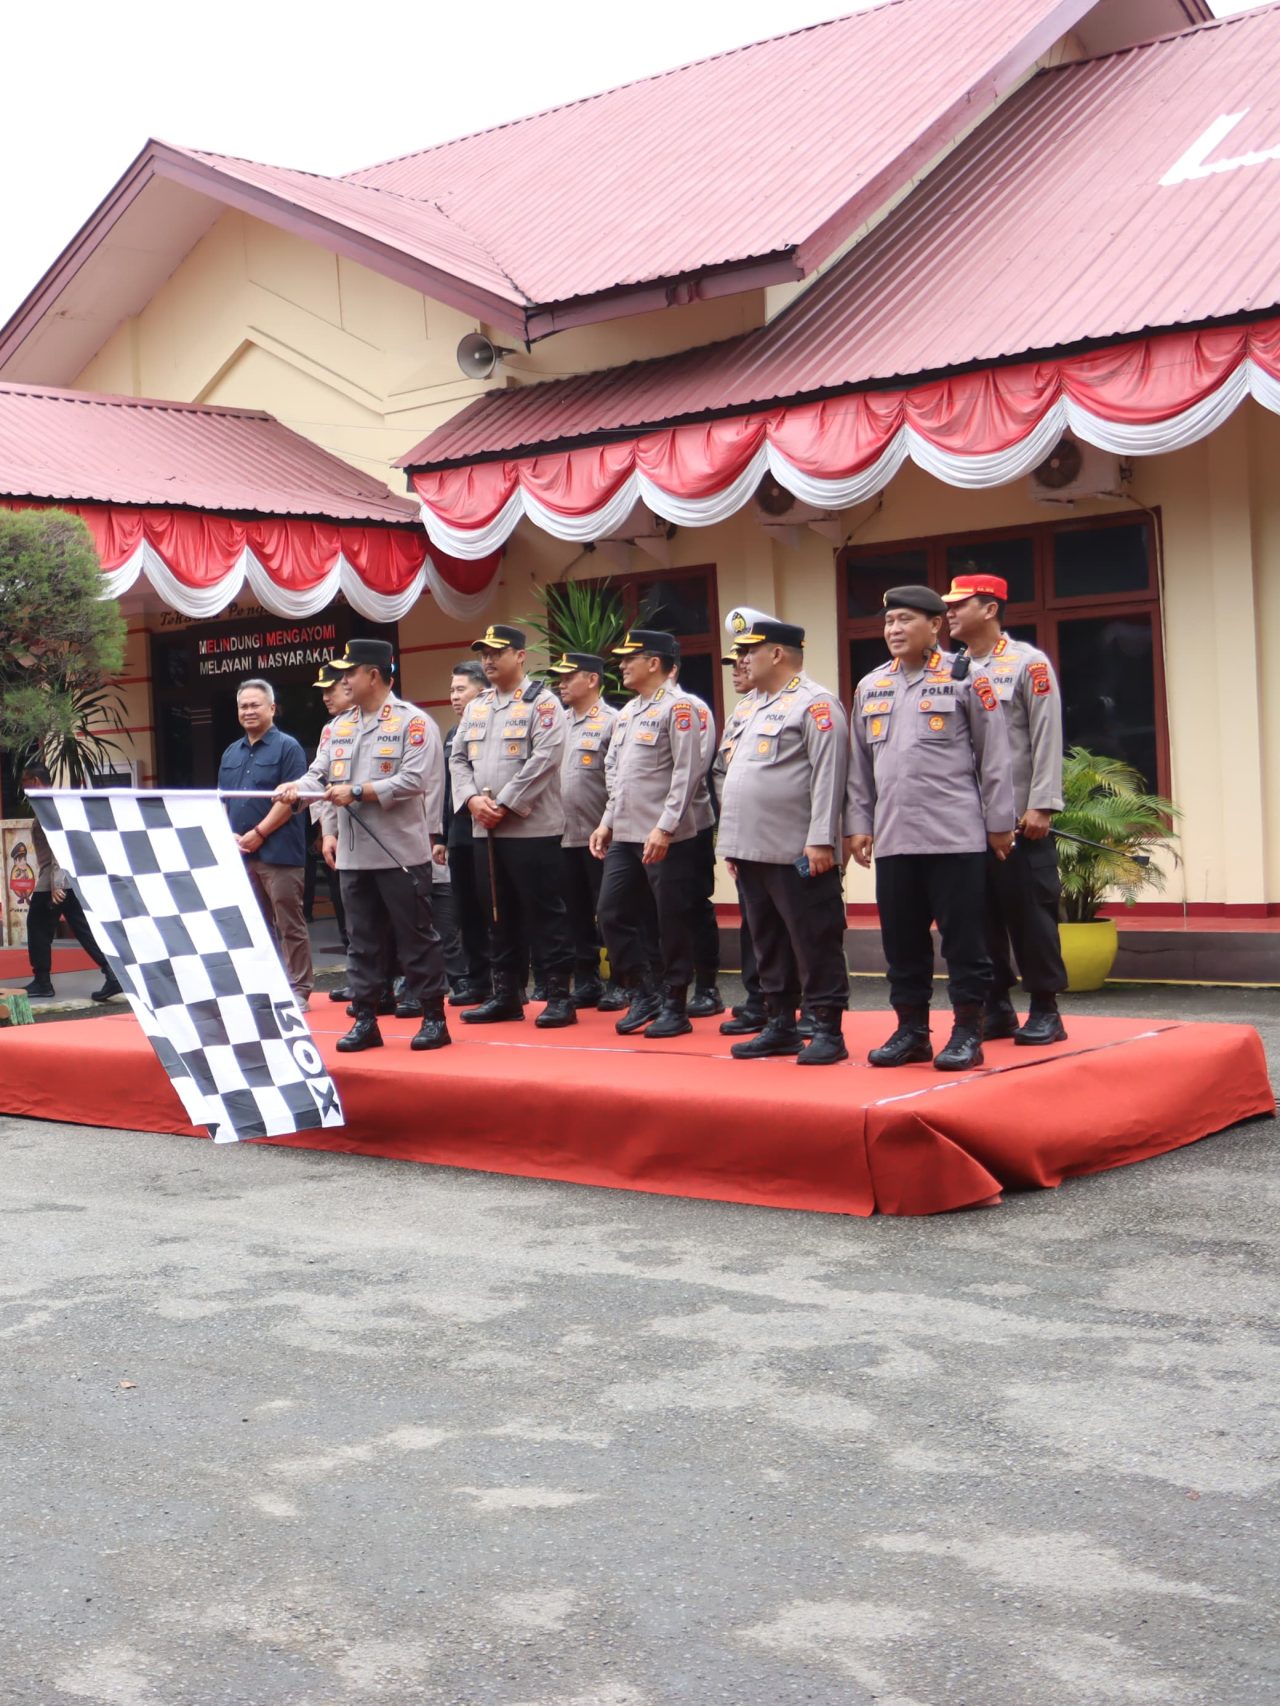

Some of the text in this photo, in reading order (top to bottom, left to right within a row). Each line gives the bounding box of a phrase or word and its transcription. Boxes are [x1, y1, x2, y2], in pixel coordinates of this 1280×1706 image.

[198, 624, 336, 655] MELINDUNGI MENGAYOMI
[199, 646, 336, 676] MELAYANI MASYARAKAT
[993, 677, 1013, 685] OLRI
[921, 686, 954, 697] POLRI
[505, 719, 529, 727] POLRI
[377, 735, 401, 743] POLRI
